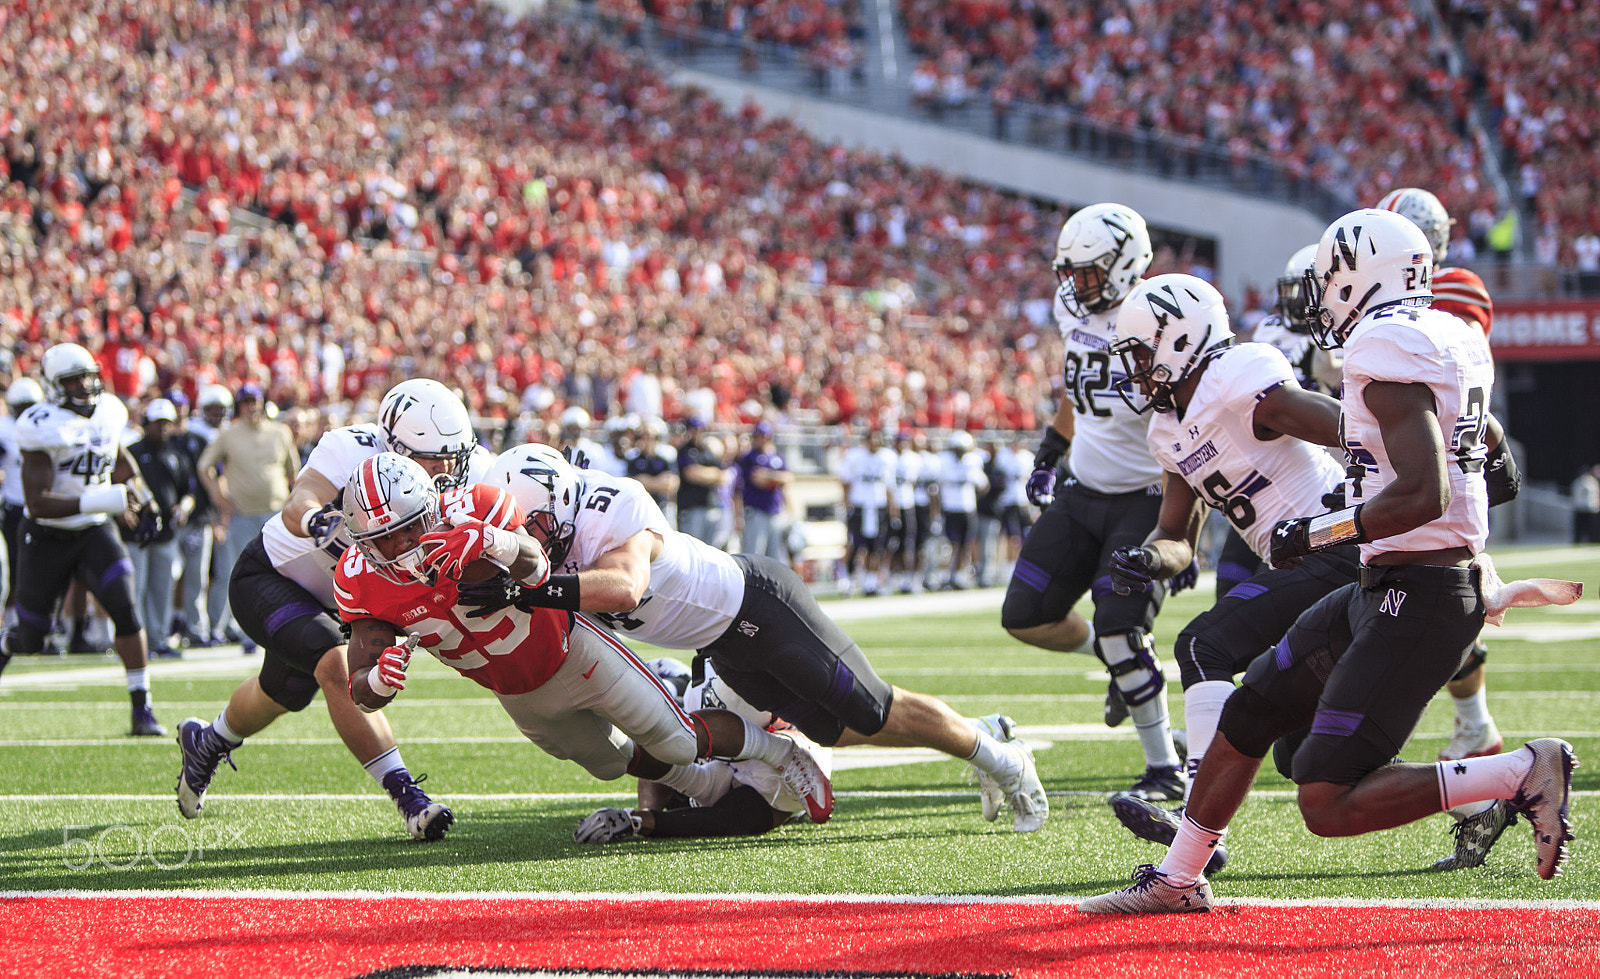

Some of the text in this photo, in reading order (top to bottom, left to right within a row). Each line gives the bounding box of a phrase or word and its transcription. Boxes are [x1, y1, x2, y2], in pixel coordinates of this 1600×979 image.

[1332, 226, 1362, 272] N
[1401, 265, 1428, 291] 24
[1146, 285, 1184, 321] N
[1064, 351, 1113, 417] 92
[584, 486, 621, 514] 51
[1193, 469, 1257, 531] 6
[1379, 588, 1407, 617] N
[402, 602, 532, 671] 25
